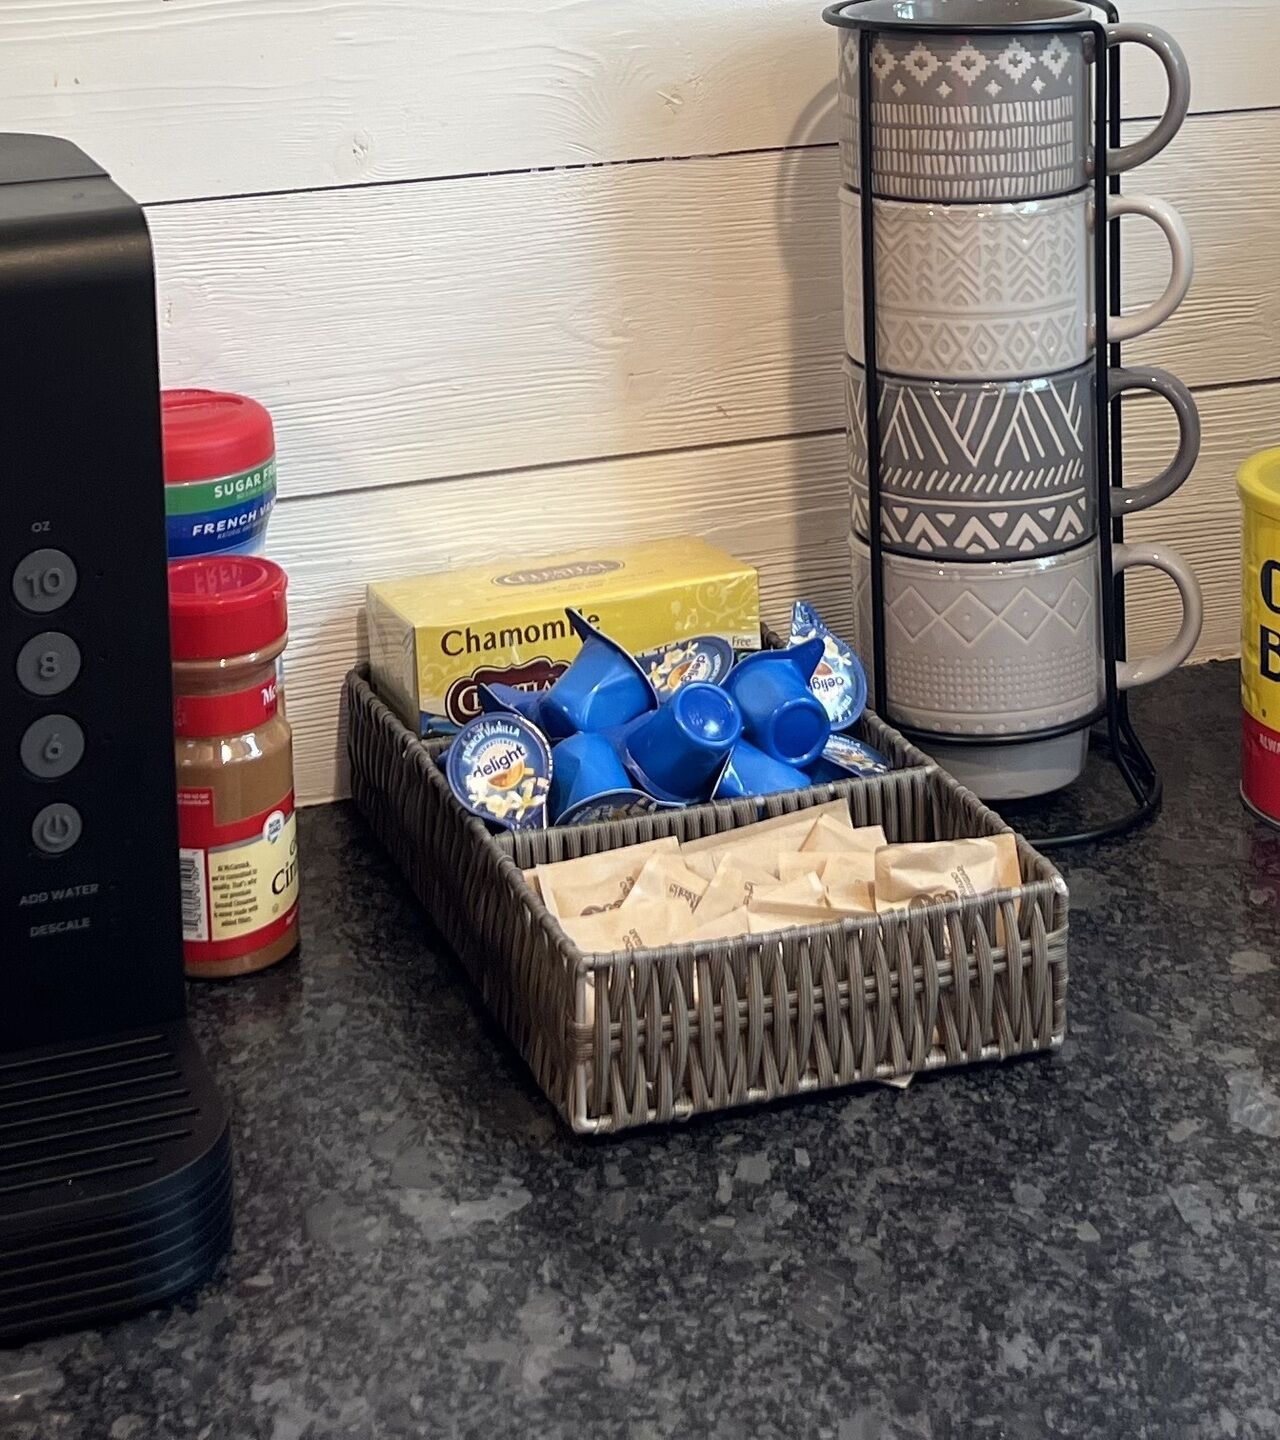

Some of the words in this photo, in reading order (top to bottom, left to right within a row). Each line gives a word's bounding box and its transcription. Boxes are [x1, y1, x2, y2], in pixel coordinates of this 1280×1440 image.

[213, 472, 262, 499] SUGAR
[192, 509, 258, 537] FRENCH
[24, 567, 65, 598] 10
[39, 650, 61, 679] 8
[44, 733, 64, 761] 6
[473, 744, 526, 778] delight
[50, 883, 100, 901] WATER
[29, 916, 91, 938] DESCALE
